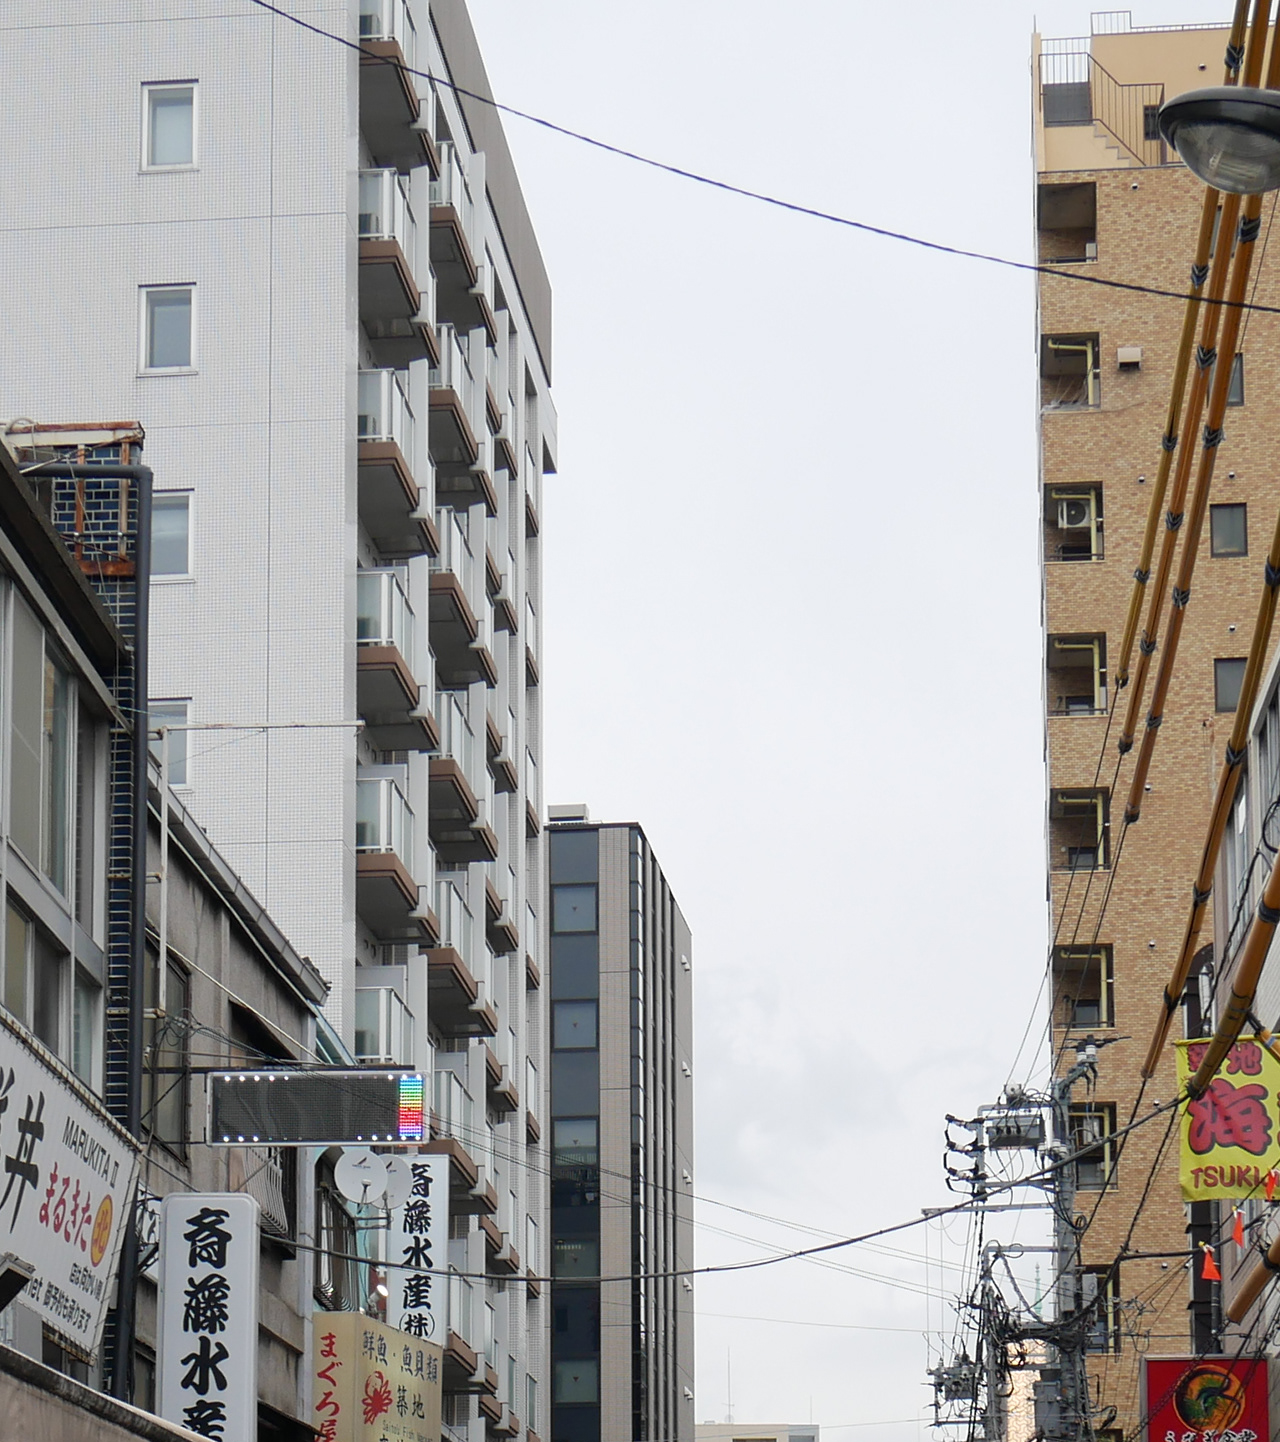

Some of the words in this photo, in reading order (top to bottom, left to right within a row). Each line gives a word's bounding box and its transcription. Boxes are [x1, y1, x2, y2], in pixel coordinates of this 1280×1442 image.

[62, 1115, 111, 1183] MARUKITA
[38, 1161, 93, 1252] まるきた
[397, 1385, 425, 1419] 築地
